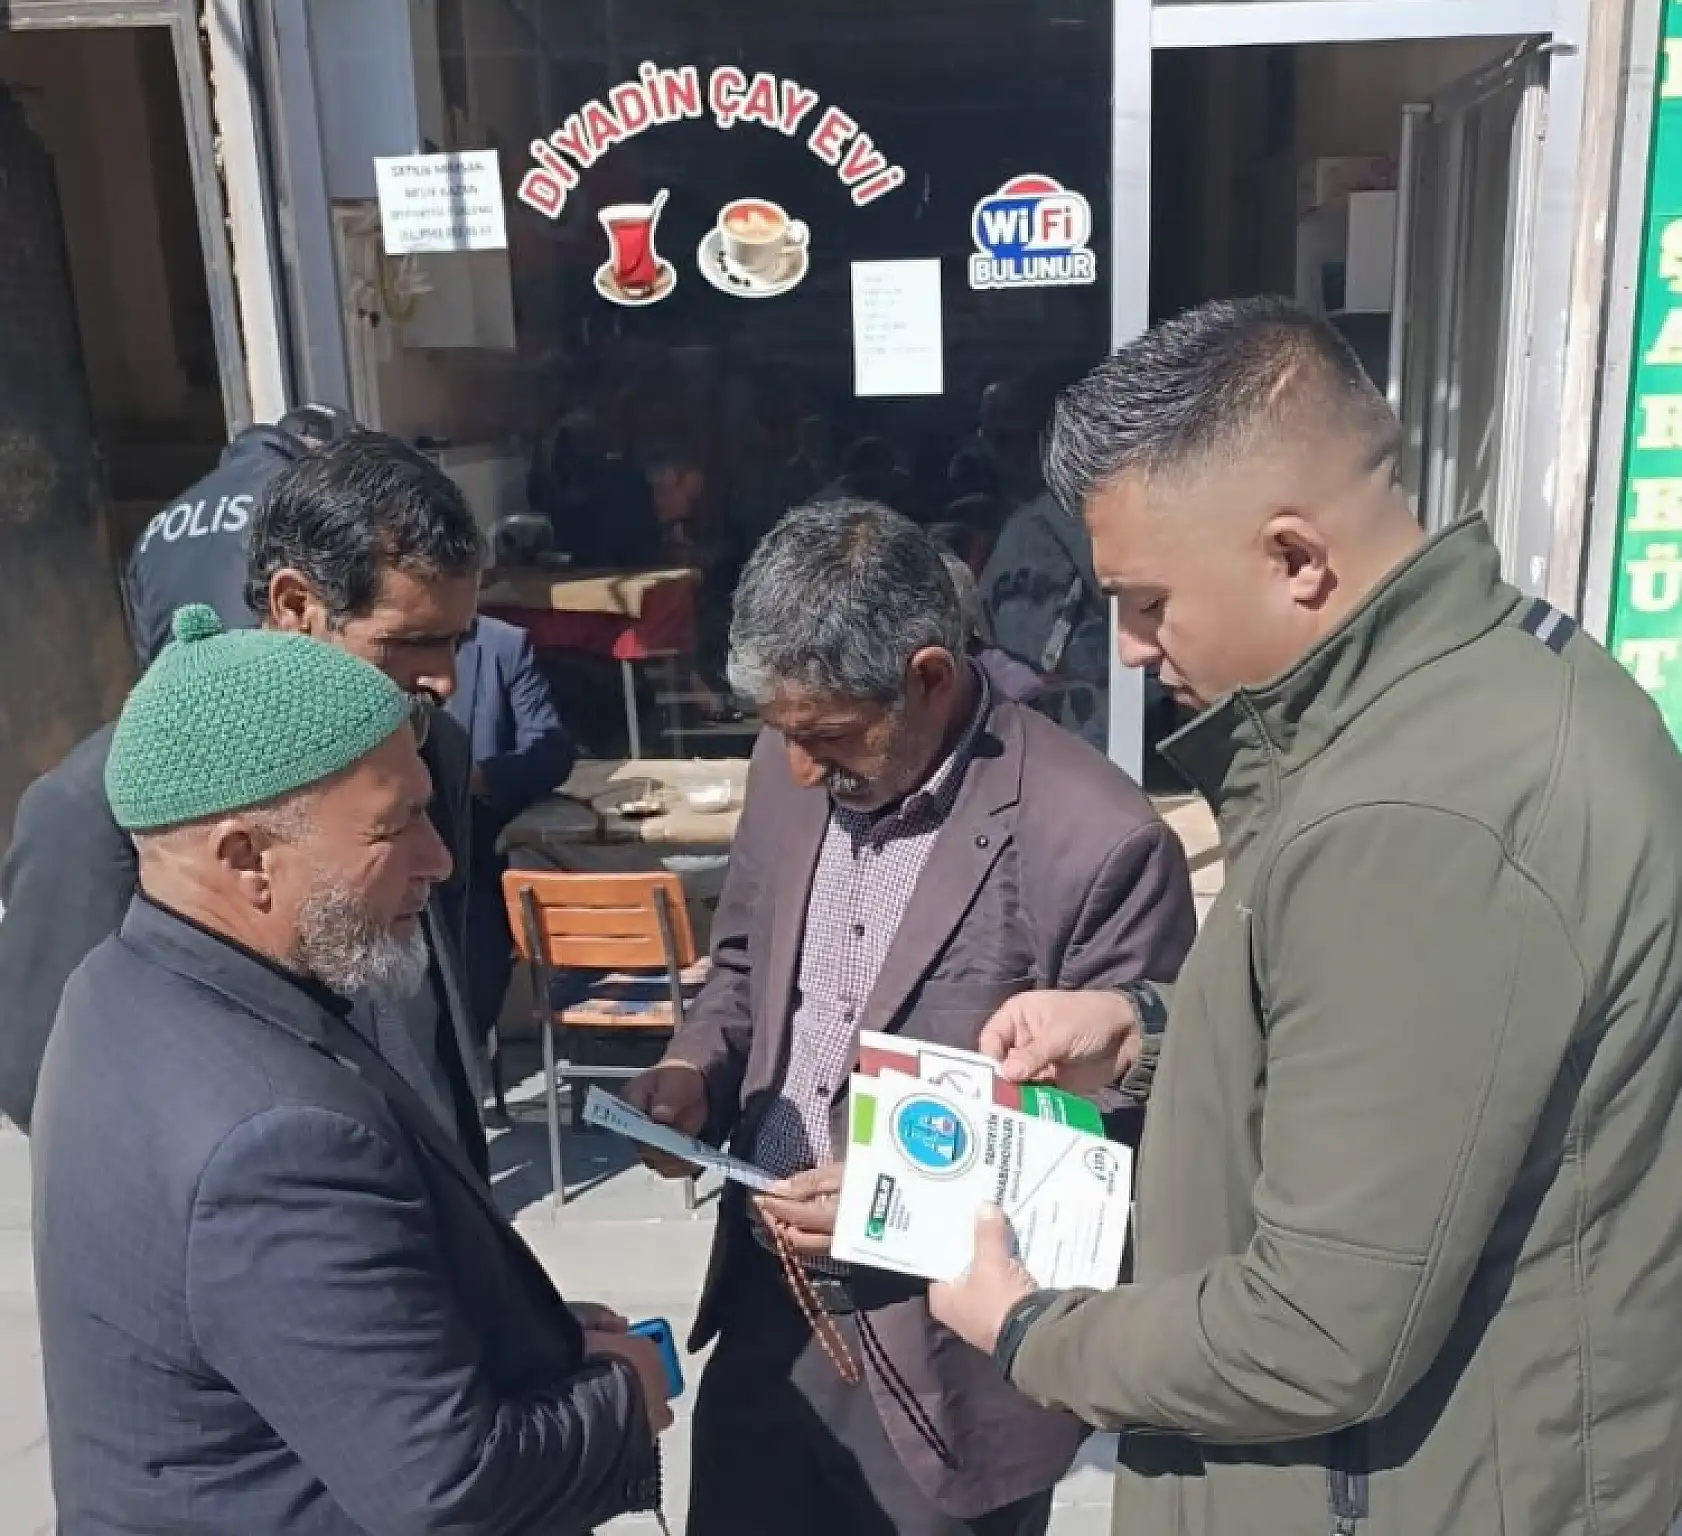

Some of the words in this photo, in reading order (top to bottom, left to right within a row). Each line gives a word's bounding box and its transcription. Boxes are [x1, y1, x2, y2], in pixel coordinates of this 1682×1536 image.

[518, 61, 702, 218] DİYADİN
[709, 65, 819, 128] ÇAY
[808, 106, 905, 206] EVİ
[973, 252, 1092, 285] BULUNUR
[139, 494, 255, 554] POLIS
